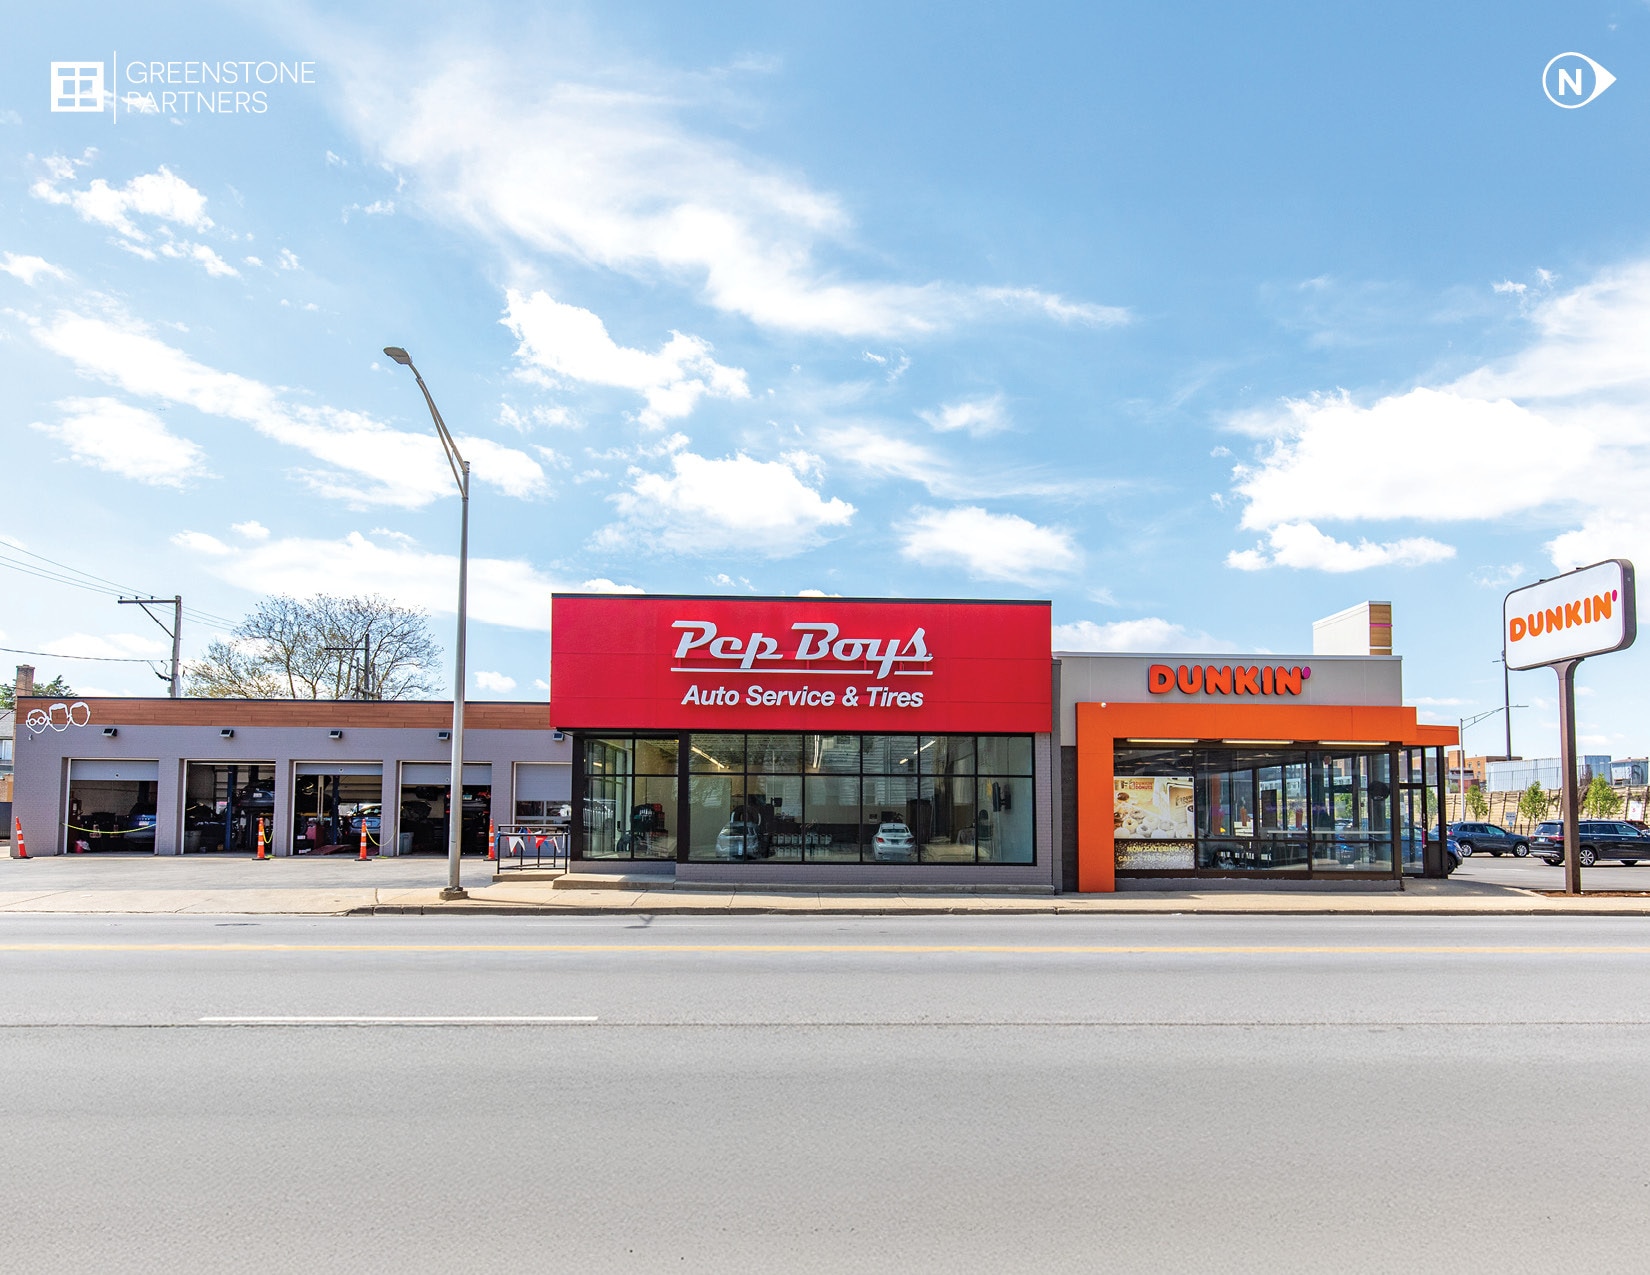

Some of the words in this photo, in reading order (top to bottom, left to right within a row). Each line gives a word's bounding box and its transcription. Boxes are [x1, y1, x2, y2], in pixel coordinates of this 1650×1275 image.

[1509, 589, 1618, 643] DUNKIN'
[671, 620, 783, 669] Pep
[791, 622, 934, 679] Boys
[681, 684, 740, 706] Auto
[746, 685, 836, 706] Service
[841, 686, 859, 707] &
[866, 686, 924, 708] Tires
[1149, 664, 1312, 696] DUNKIN'
